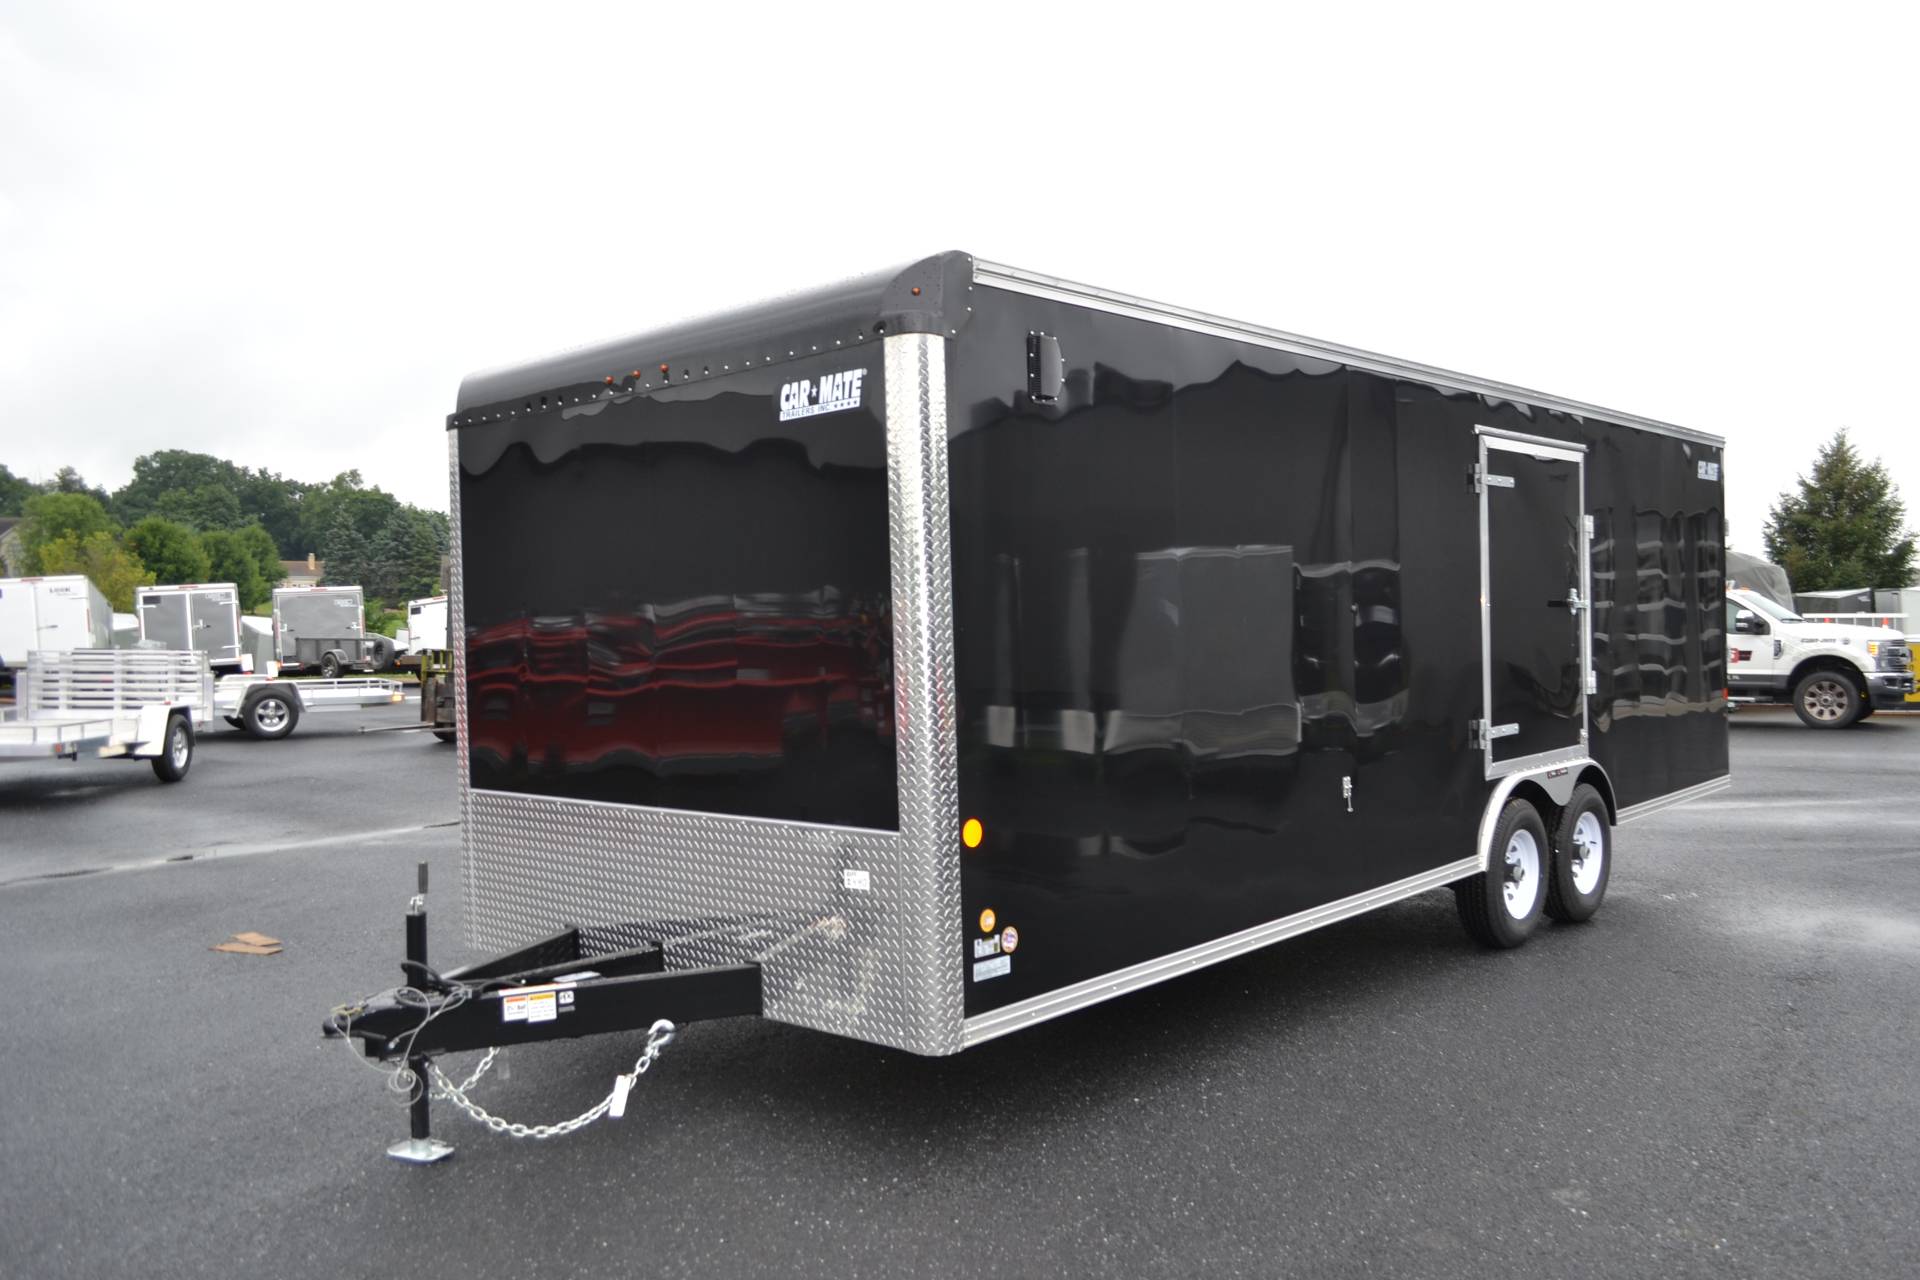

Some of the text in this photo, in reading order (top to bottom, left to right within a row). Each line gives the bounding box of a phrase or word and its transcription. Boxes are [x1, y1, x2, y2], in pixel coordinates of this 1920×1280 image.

[780, 368, 863, 411] CAR MATE
[782, 406, 816, 420] TRAILERS
